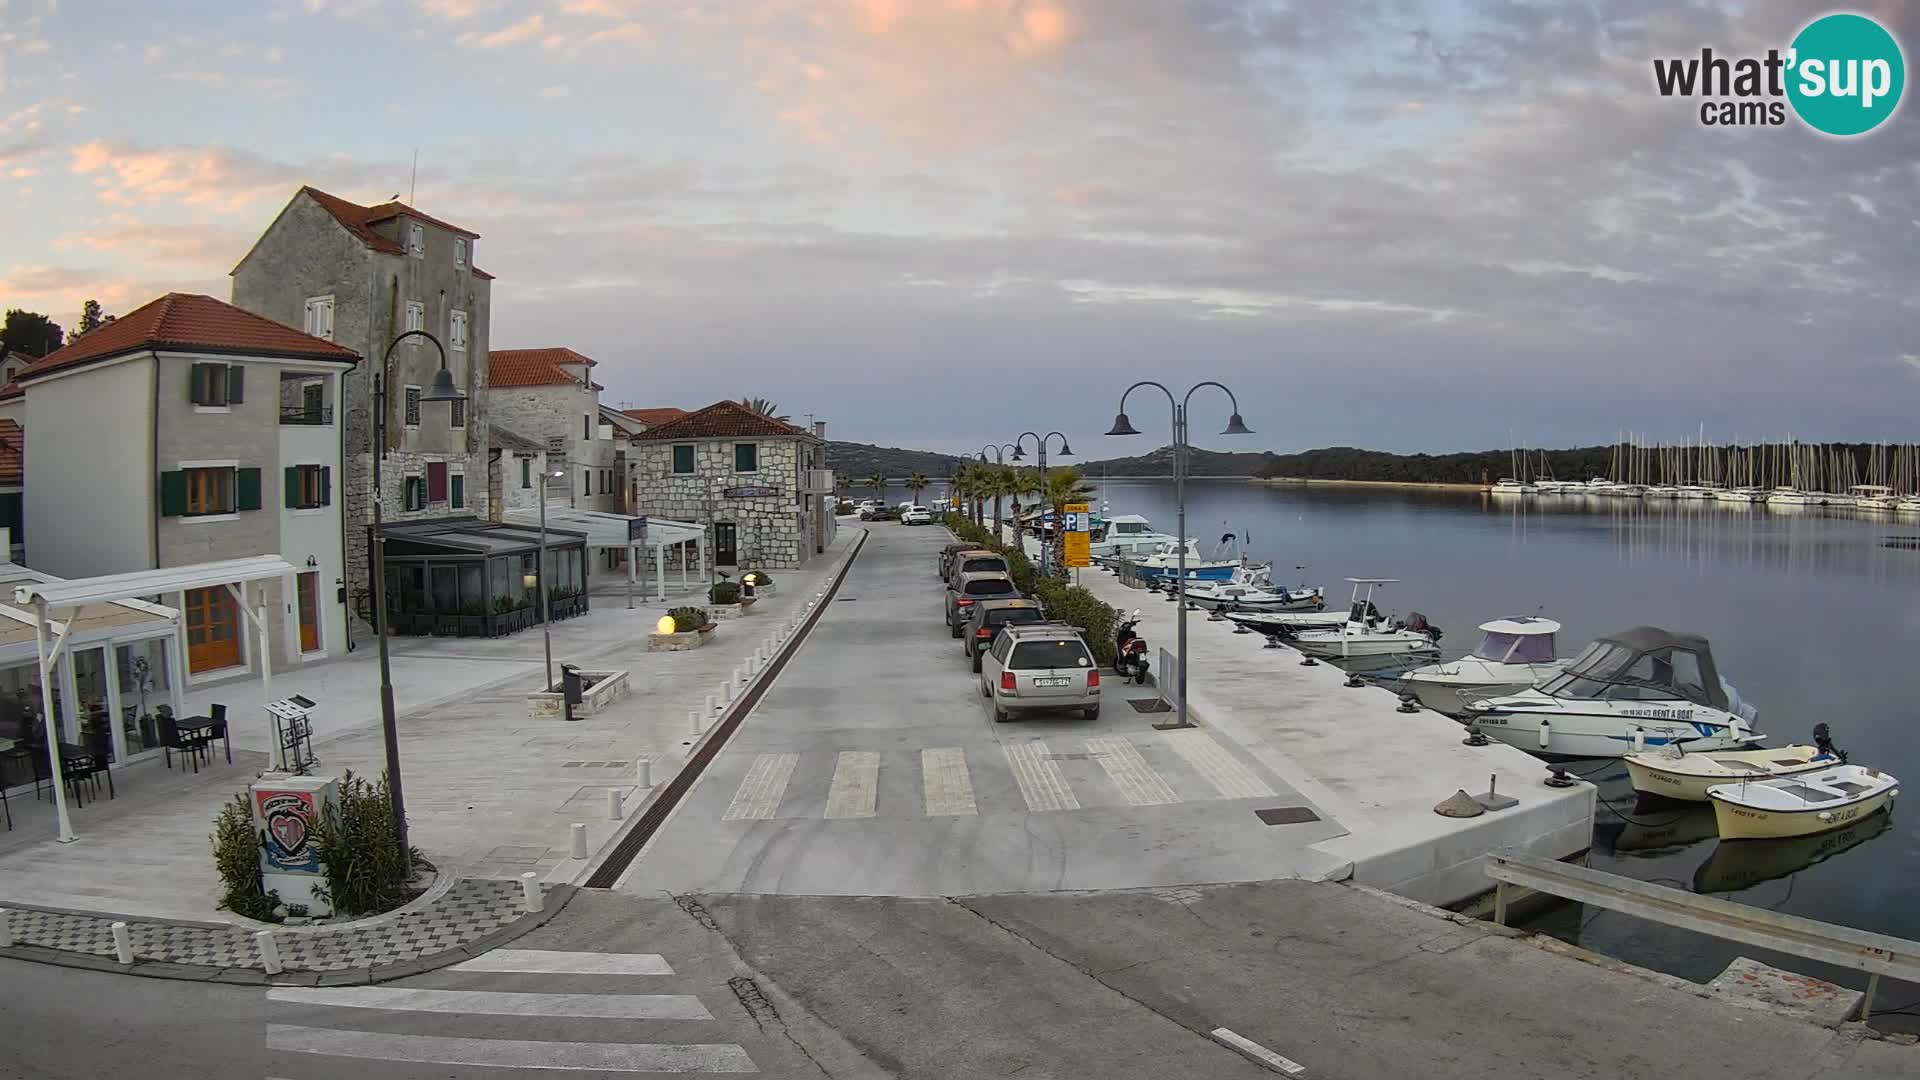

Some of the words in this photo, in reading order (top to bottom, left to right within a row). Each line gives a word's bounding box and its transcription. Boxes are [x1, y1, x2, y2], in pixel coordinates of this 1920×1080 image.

[1652, 709, 1670, 719] RENT
[1671, 709, 1676, 719] A
[1677, 709, 1694, 720] BOAT
